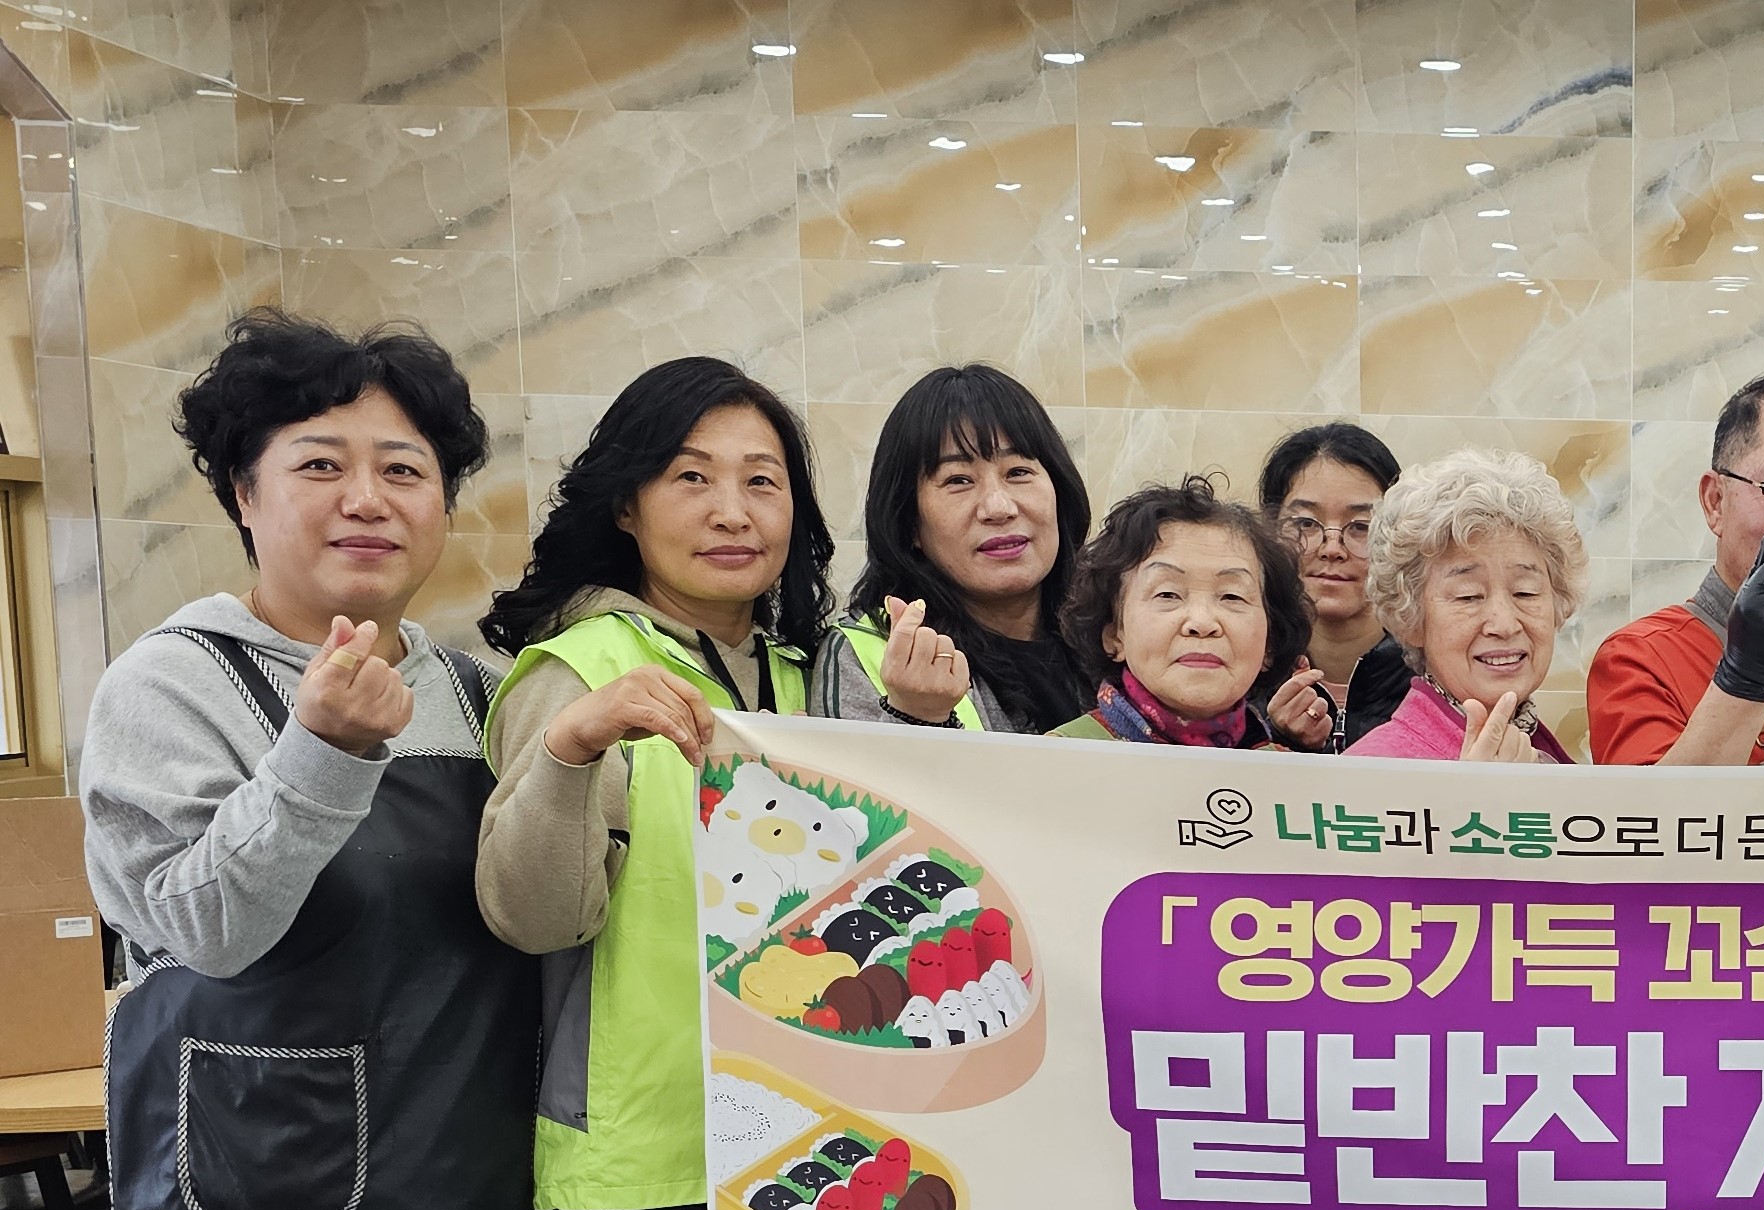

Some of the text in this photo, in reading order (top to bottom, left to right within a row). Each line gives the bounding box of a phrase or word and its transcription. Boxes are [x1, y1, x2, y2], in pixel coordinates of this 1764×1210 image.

[1273, 802, 1441, 855] 나눔과
[1449, 810, 1665, 859] 소통으로
[1677, 814, 1725, 861] 더
[1131, 1026, 1688, 1210] 밑반찬
